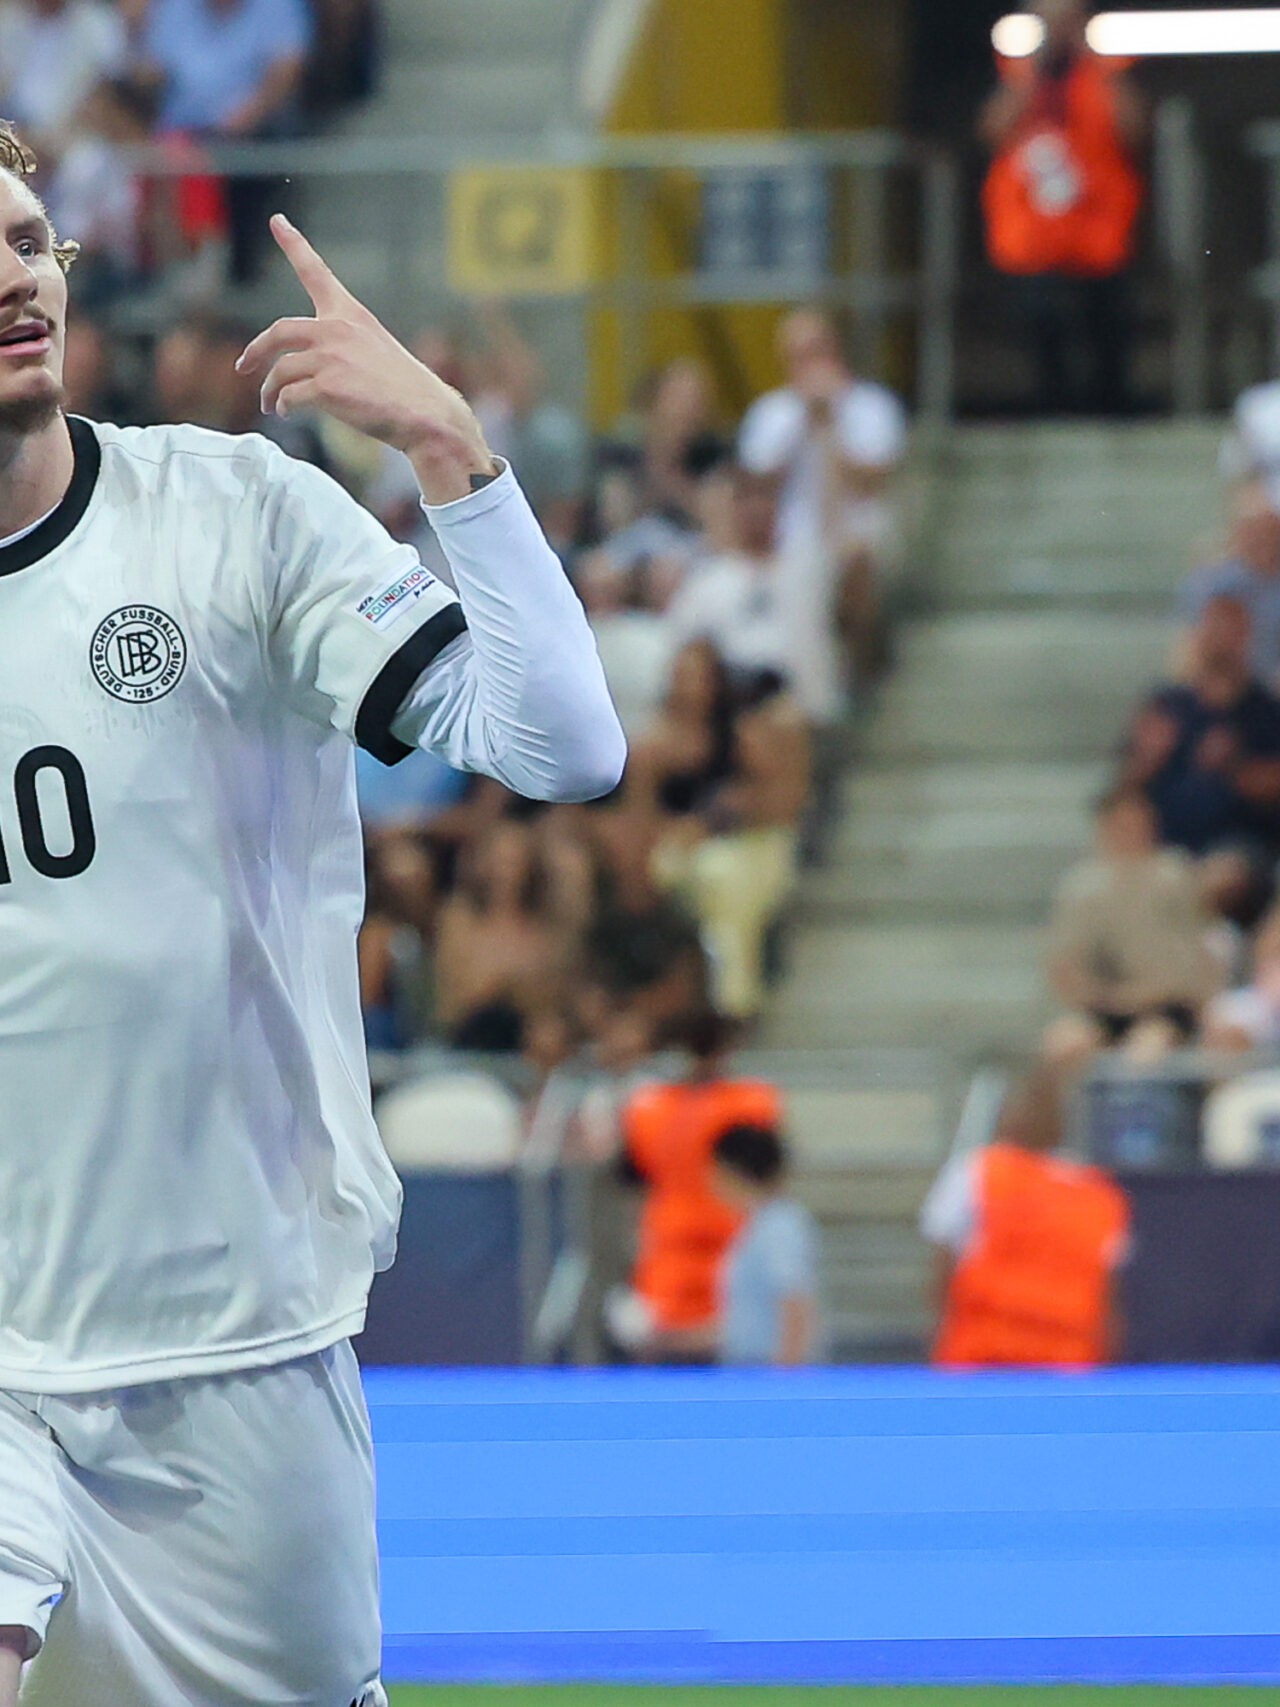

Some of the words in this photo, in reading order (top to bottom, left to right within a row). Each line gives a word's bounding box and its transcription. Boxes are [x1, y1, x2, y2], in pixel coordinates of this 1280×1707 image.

[365, 569, 427, 621] FOUNDATION
[94, 619, 123, 693] DEUTSCHER
[133, 687, 154, 699] 125
